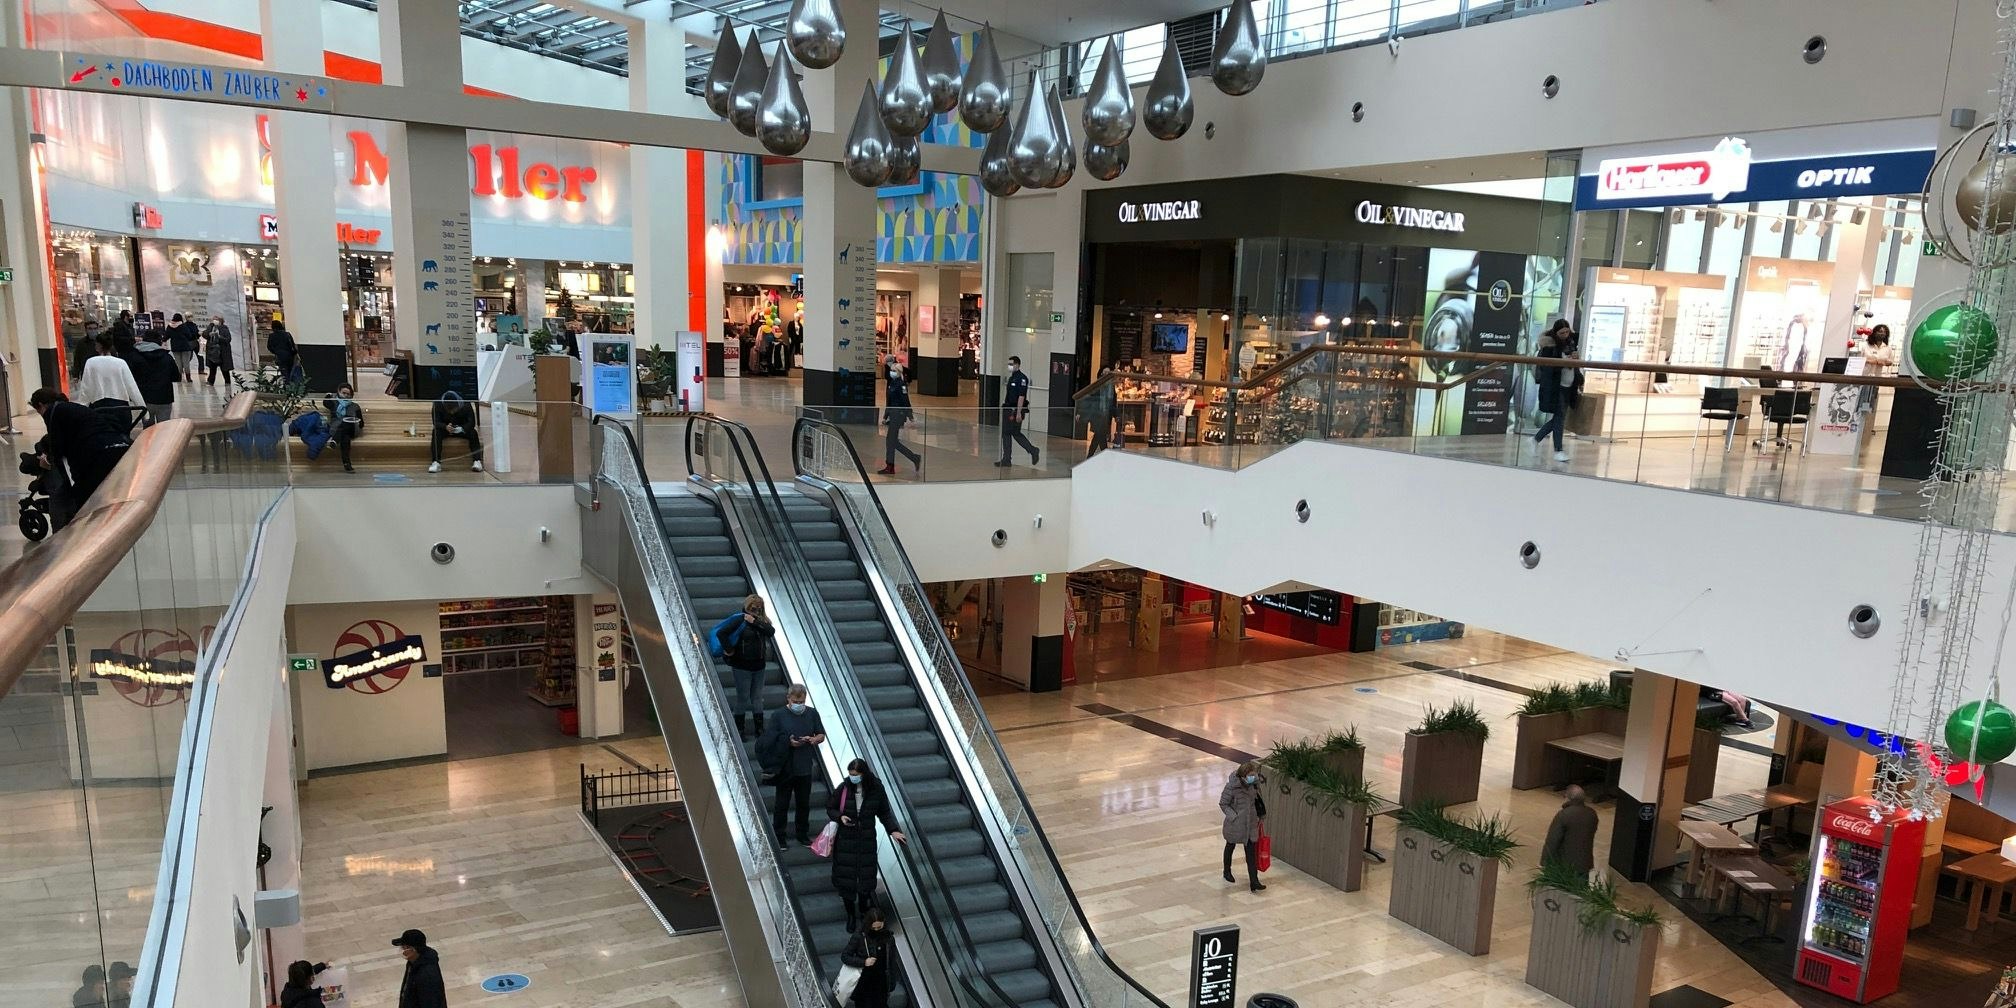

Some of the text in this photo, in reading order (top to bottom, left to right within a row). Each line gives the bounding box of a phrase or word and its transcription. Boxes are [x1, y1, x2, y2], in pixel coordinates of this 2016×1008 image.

[123, 61, 280, 100] DACHBODEN ZAUBER
[347, 131, 597, 202] Mller
[1797, 166, 1875, 188] OPTIK
[724, 347, 738, 355] 50%
